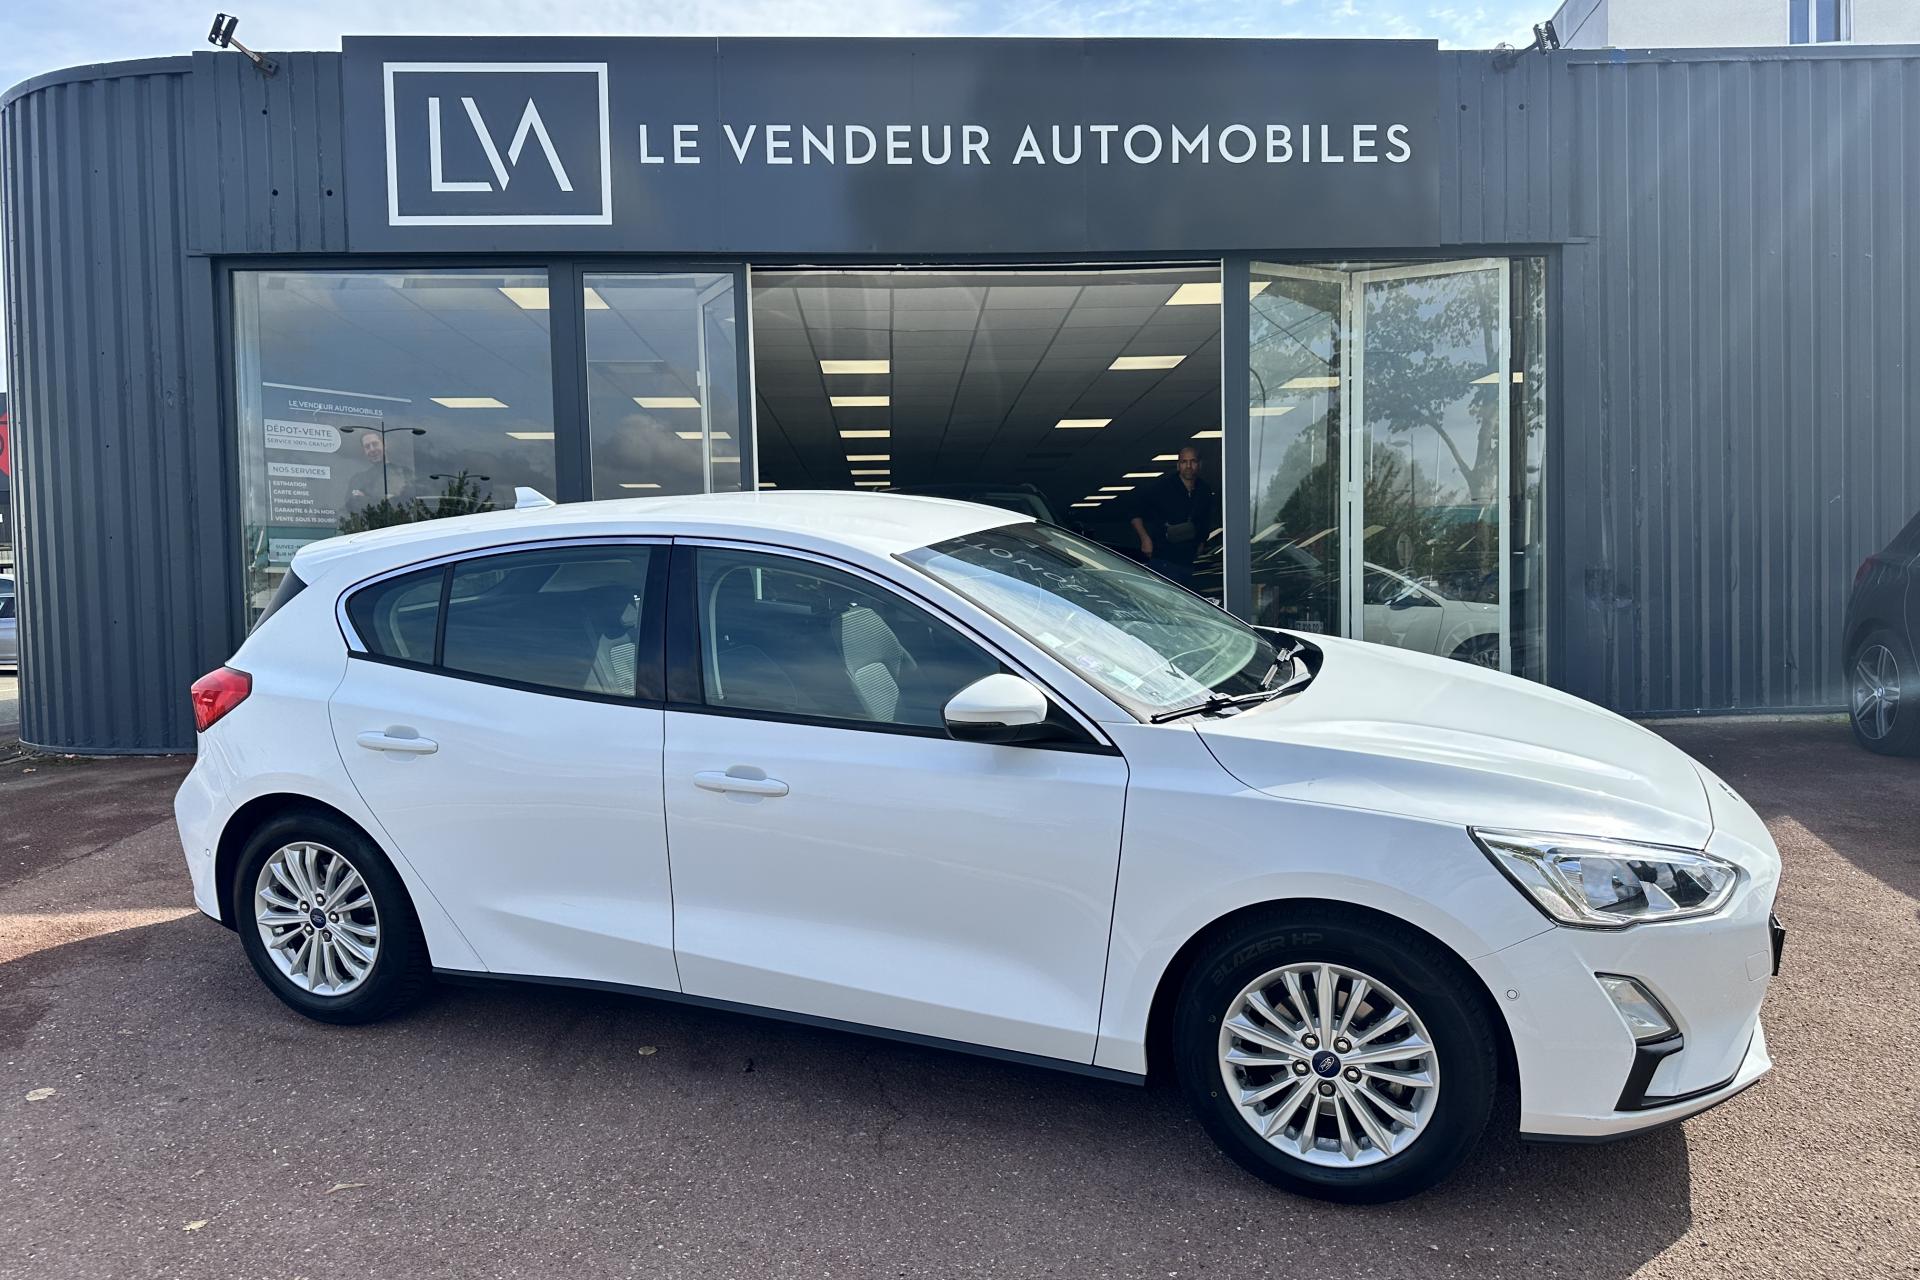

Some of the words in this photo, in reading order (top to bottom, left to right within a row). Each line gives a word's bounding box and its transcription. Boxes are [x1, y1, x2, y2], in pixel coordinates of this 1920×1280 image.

[640, 124, 700, 164] LE
[723, 124, 991, 165] VENDEUR
[1012, 123, 1411, 164] AUTOMOBILES
[299, 401, 334, 410] VENDEUR
[335, 404, 384, 416] AUTOMOBILES
[266, 423, 333, 438] DÉPOT-VENTE
[267, 437, 291, 445] SERVICE
[272, 465, 289, 473] NOS
[290, 466, 326, 476] SERVICES
[272, 480, 307, 488] ESTIMATION
[1291, 932, 1324, 946] HP
